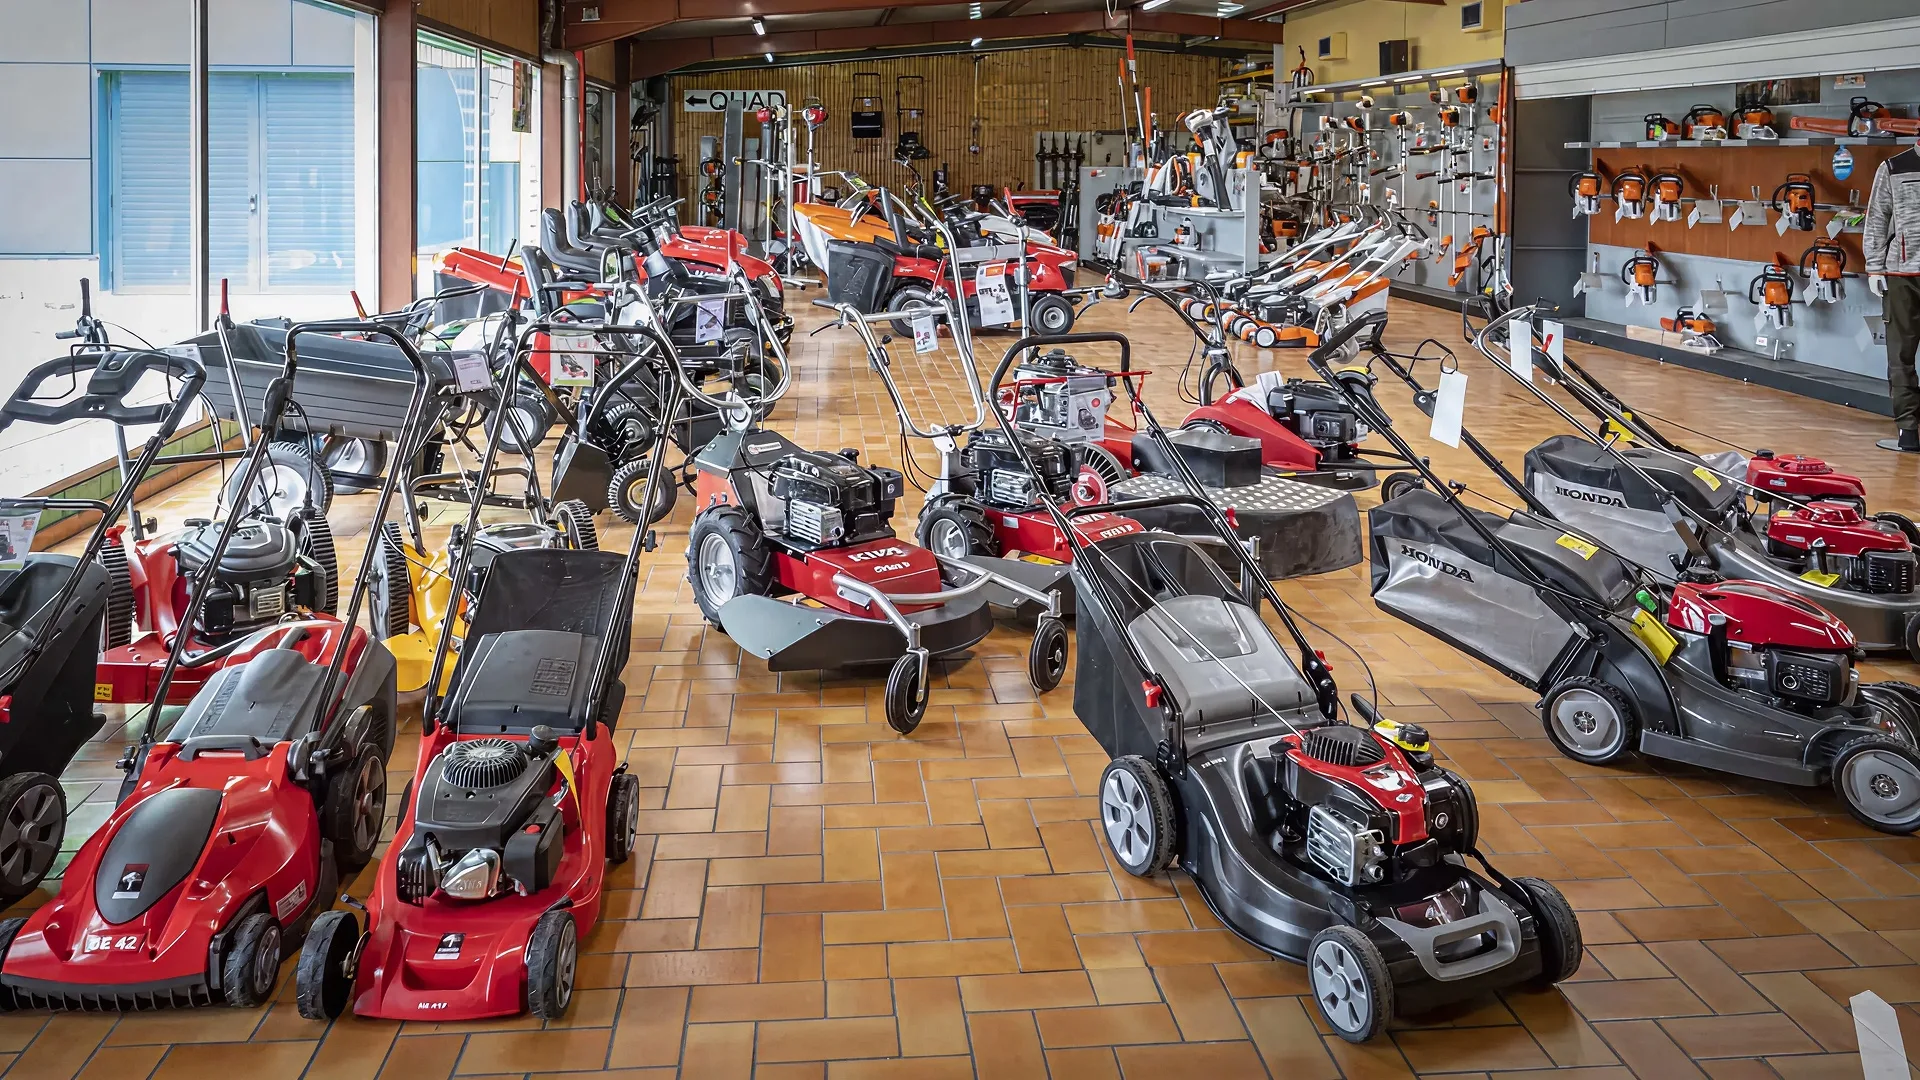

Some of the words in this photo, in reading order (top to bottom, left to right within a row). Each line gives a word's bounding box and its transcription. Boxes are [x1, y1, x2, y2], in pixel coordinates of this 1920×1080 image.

[709, 91, 785, 111] QUAD
[1555, 485, 1628, 509] HONDA
[848, 546, 903, 562] KIVA
[1401, 544, 1475, 583] HONDA
[115, 936, 137, 950] 42
